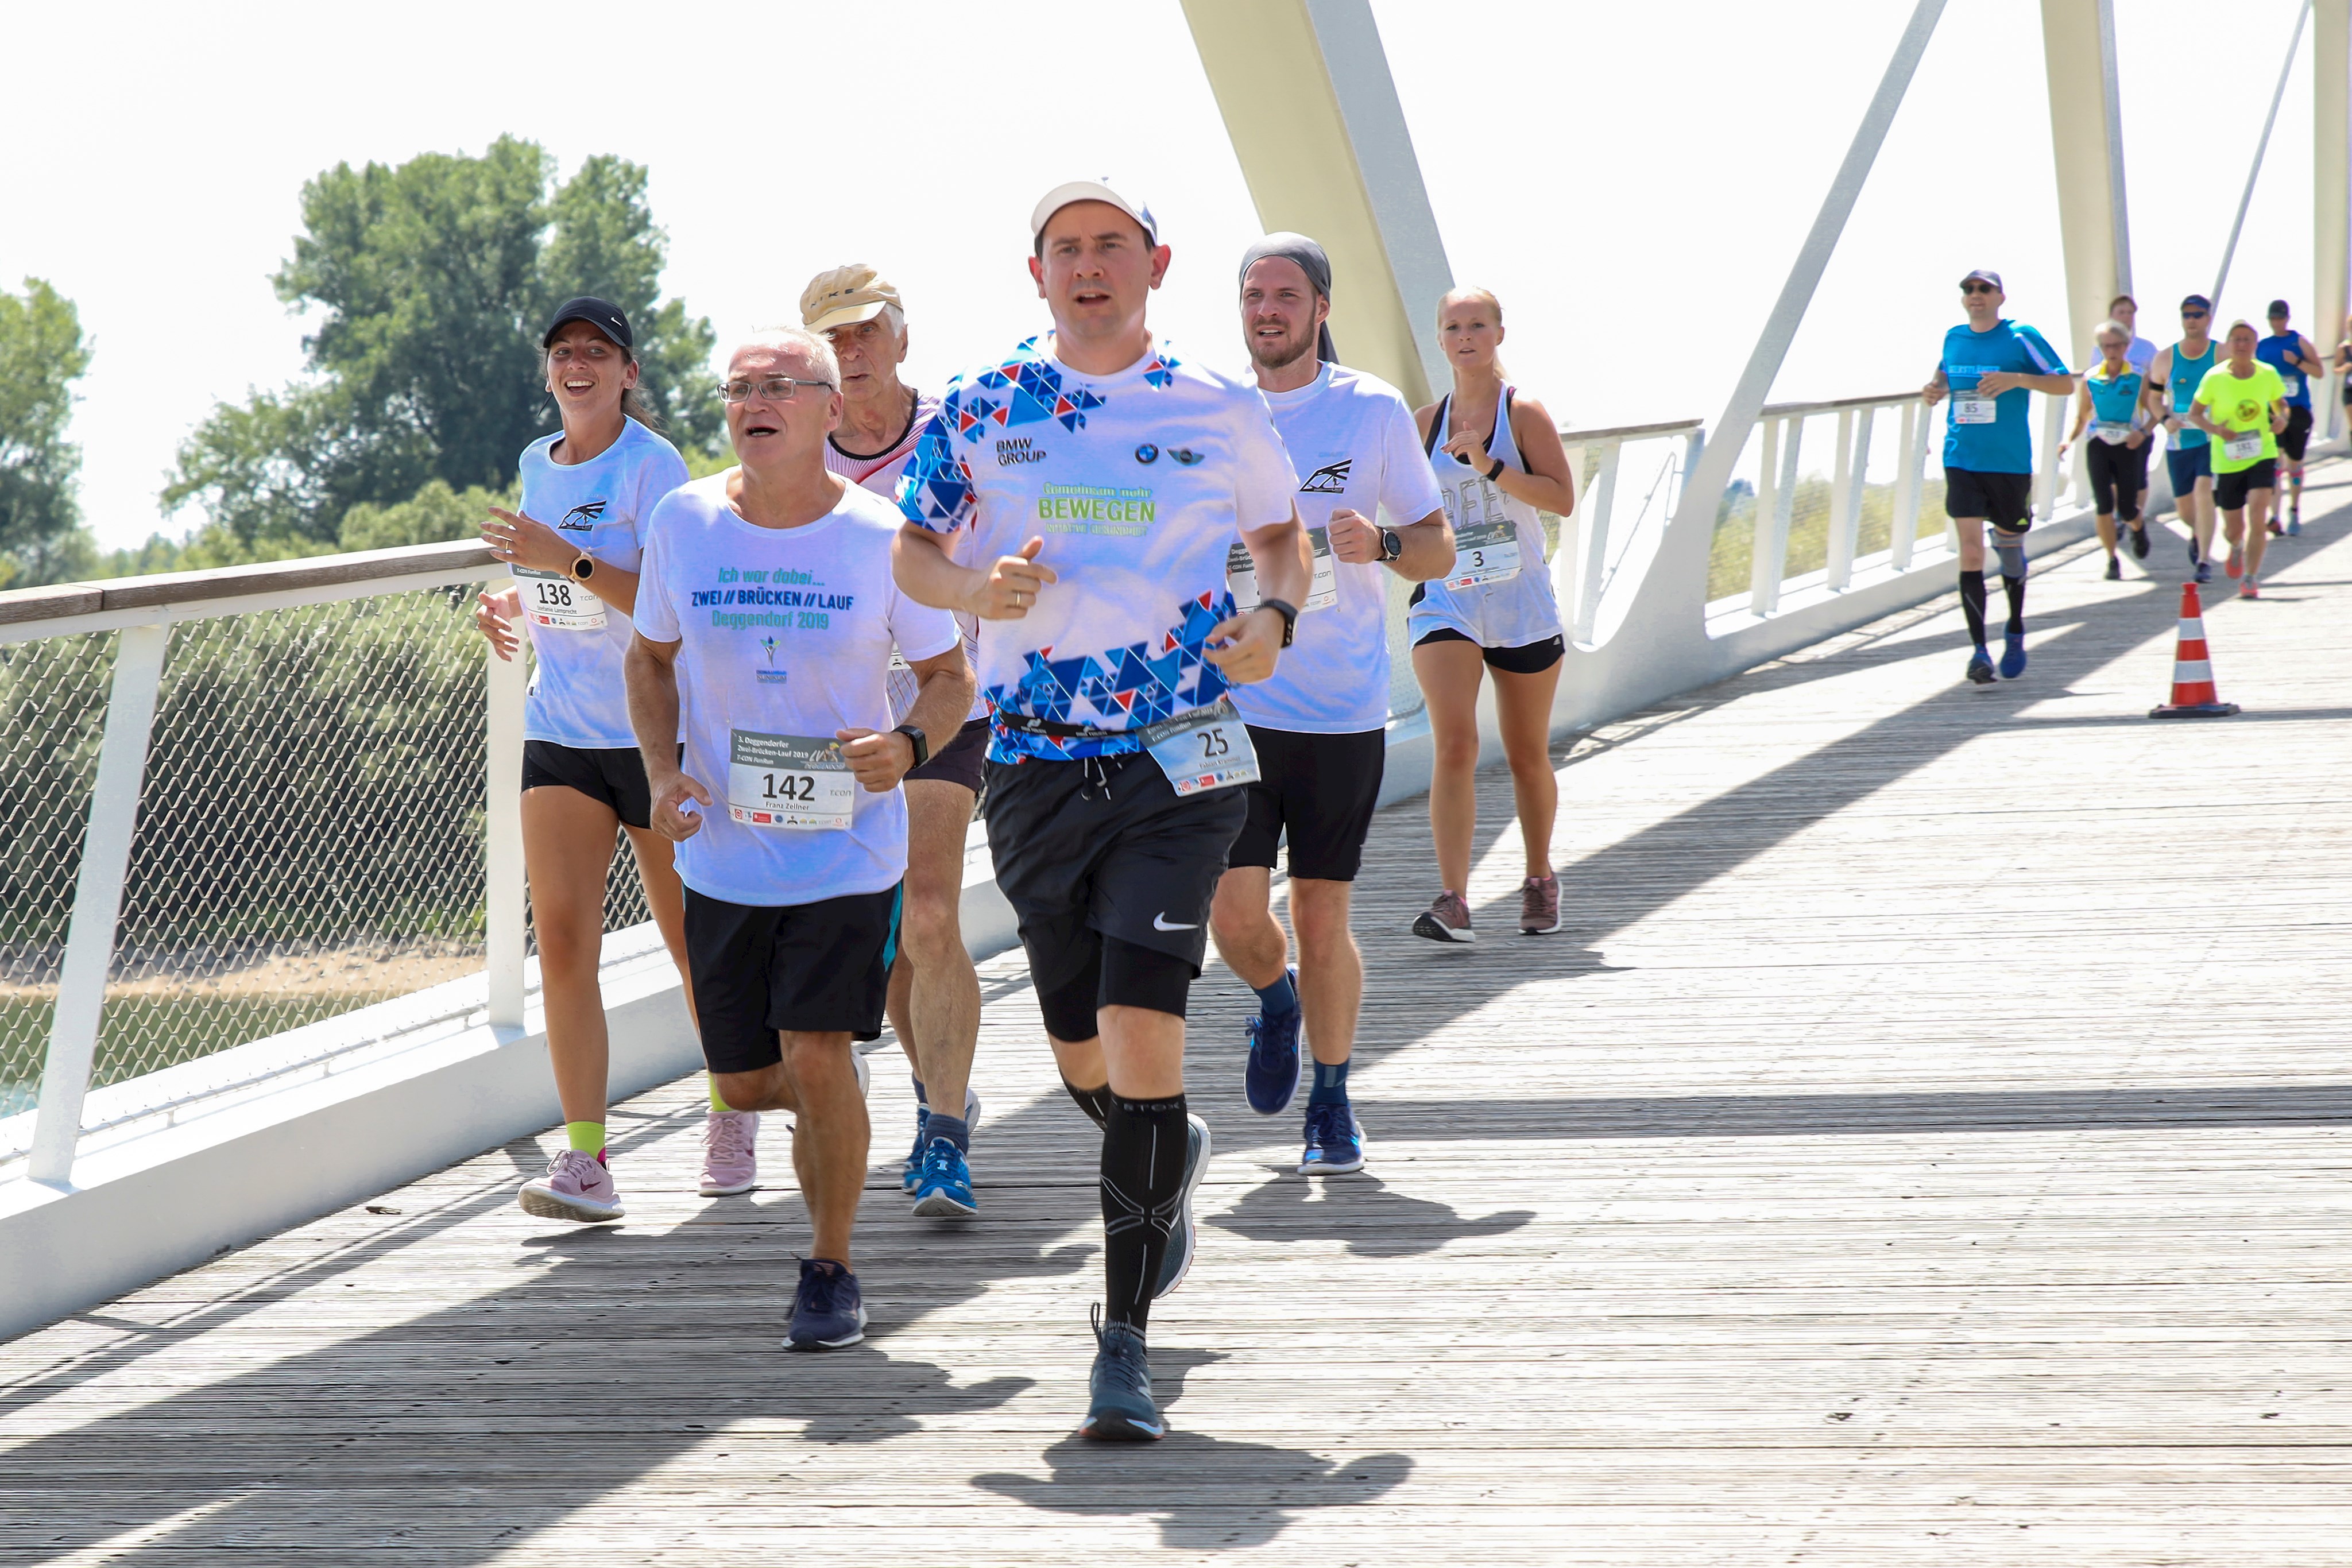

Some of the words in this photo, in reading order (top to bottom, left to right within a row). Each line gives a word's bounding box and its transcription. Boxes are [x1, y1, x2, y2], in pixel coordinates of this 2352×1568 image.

[810, 288, 854, 309] NIKE
[996, 437, 1032, 453] BMW
[998, 450, 1047, 467] GROUP
[1043, 482, 1116, 496] Gemeinsam
[1120, 487, 1152, 498] mehr
[1038, 497, 1155, 523] BEWEGEN
[1472, 551, 1485, 568] 3
[718, 567, 738, 583] Ich
[742, 570, 769, 583] war
[772, 567, 825, 586] dabei...
[536, 582, 572, 607] 138
[691, 590, 722, 607] ZWEI
[737, 586, 802, 607] BRÜCKEN
[818, 594, 854, 610] LAUF
[711, 610, 794, 630] Deggendorf
[797, 611, 829, 630] 2019
[738, 735, 744, 744] 3.
[745, 736, 789, 748] Deggendorfer
[1197, 727, 1228, 758] 25
[736, 754, 753, 762] T-CON
[753, 756, 774, 765] FunRun
[737, 745, 792, 758] Zwei-Brücken-Lauf
[793, 750, 809, 758] 2019
[762, 773, 815, 802] 142
[765, 801, 784, 809] Franz
[785, 803, 810, 811] Zellner
